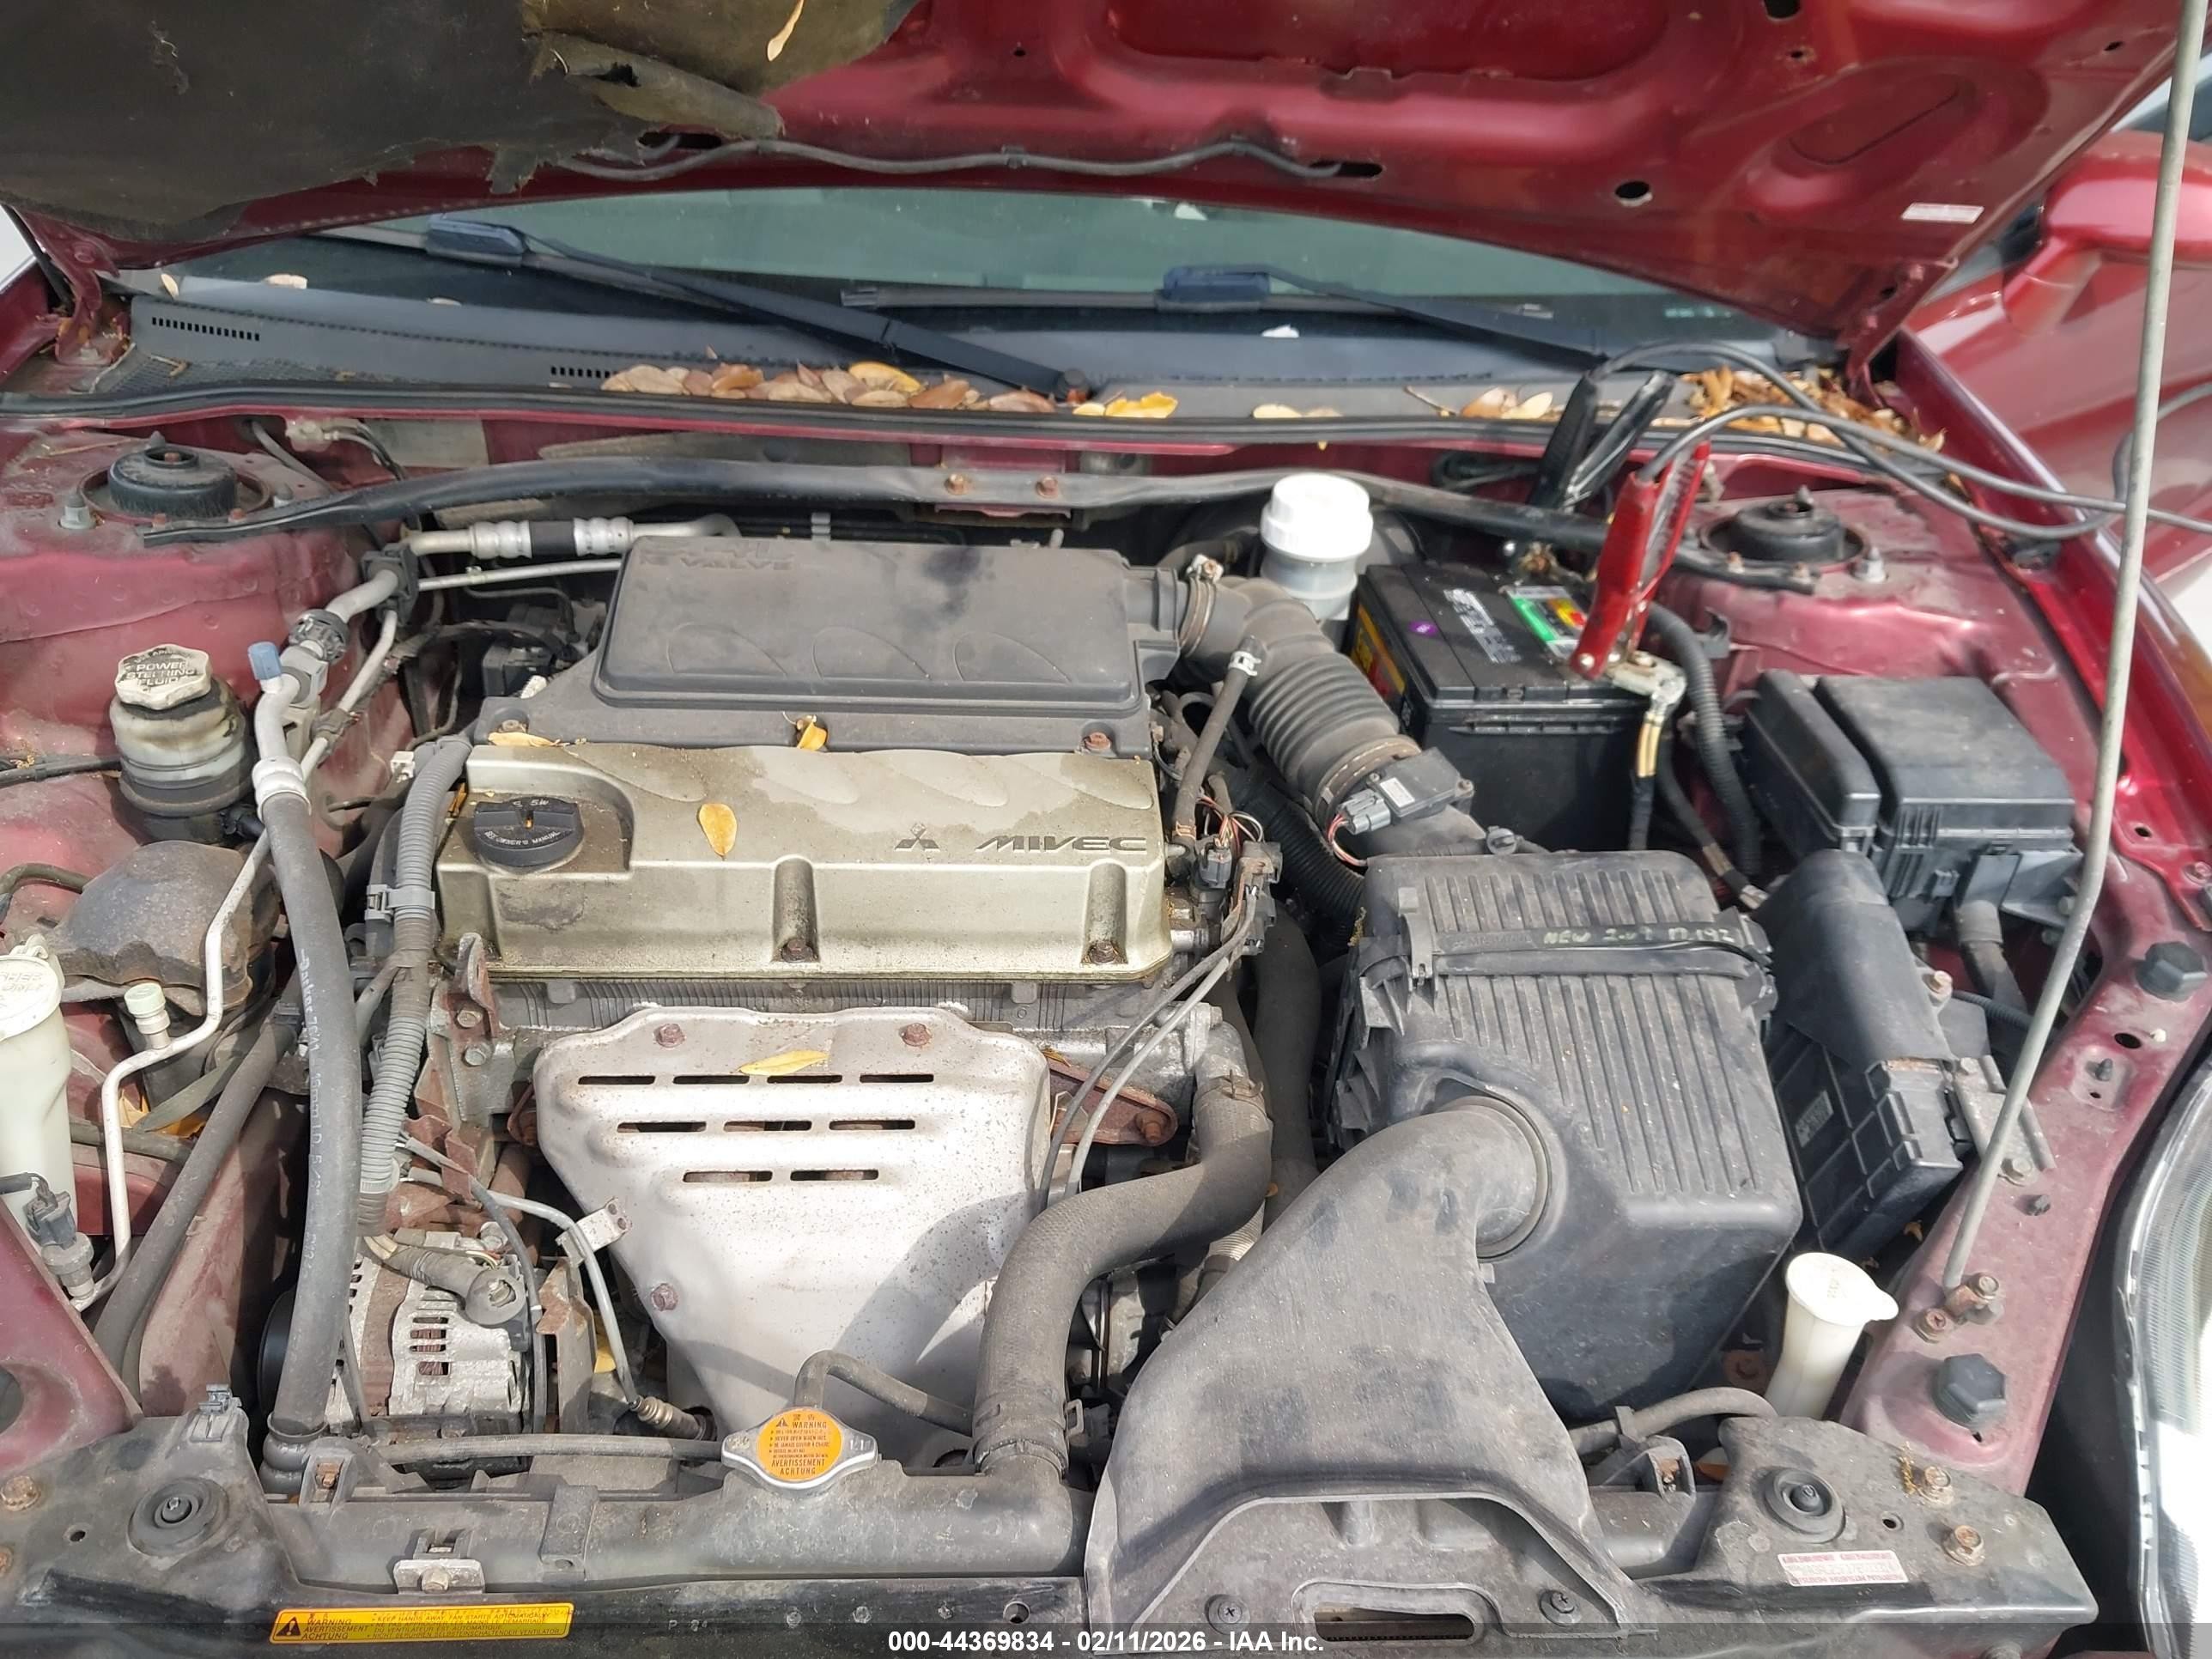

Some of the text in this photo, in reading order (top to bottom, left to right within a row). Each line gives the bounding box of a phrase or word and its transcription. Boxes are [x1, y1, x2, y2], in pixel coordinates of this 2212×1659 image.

[136, 661, 188, 672] POWER
[126, 670, 196, 679] STEERING
[137, 677, 179, 687] FLUID
[975, 835, 1147, 852] MIVEC
[1543, 930, 1592, 944] NEW
[792, 1421, 828, 1430] WARNING
[771, 1458, 825, 1468] AVERTISSEMENT
[780, 1467, 816, 1475] ACHTUNG
[303, 1625, 368, 1633] AVERTISSEMENT
